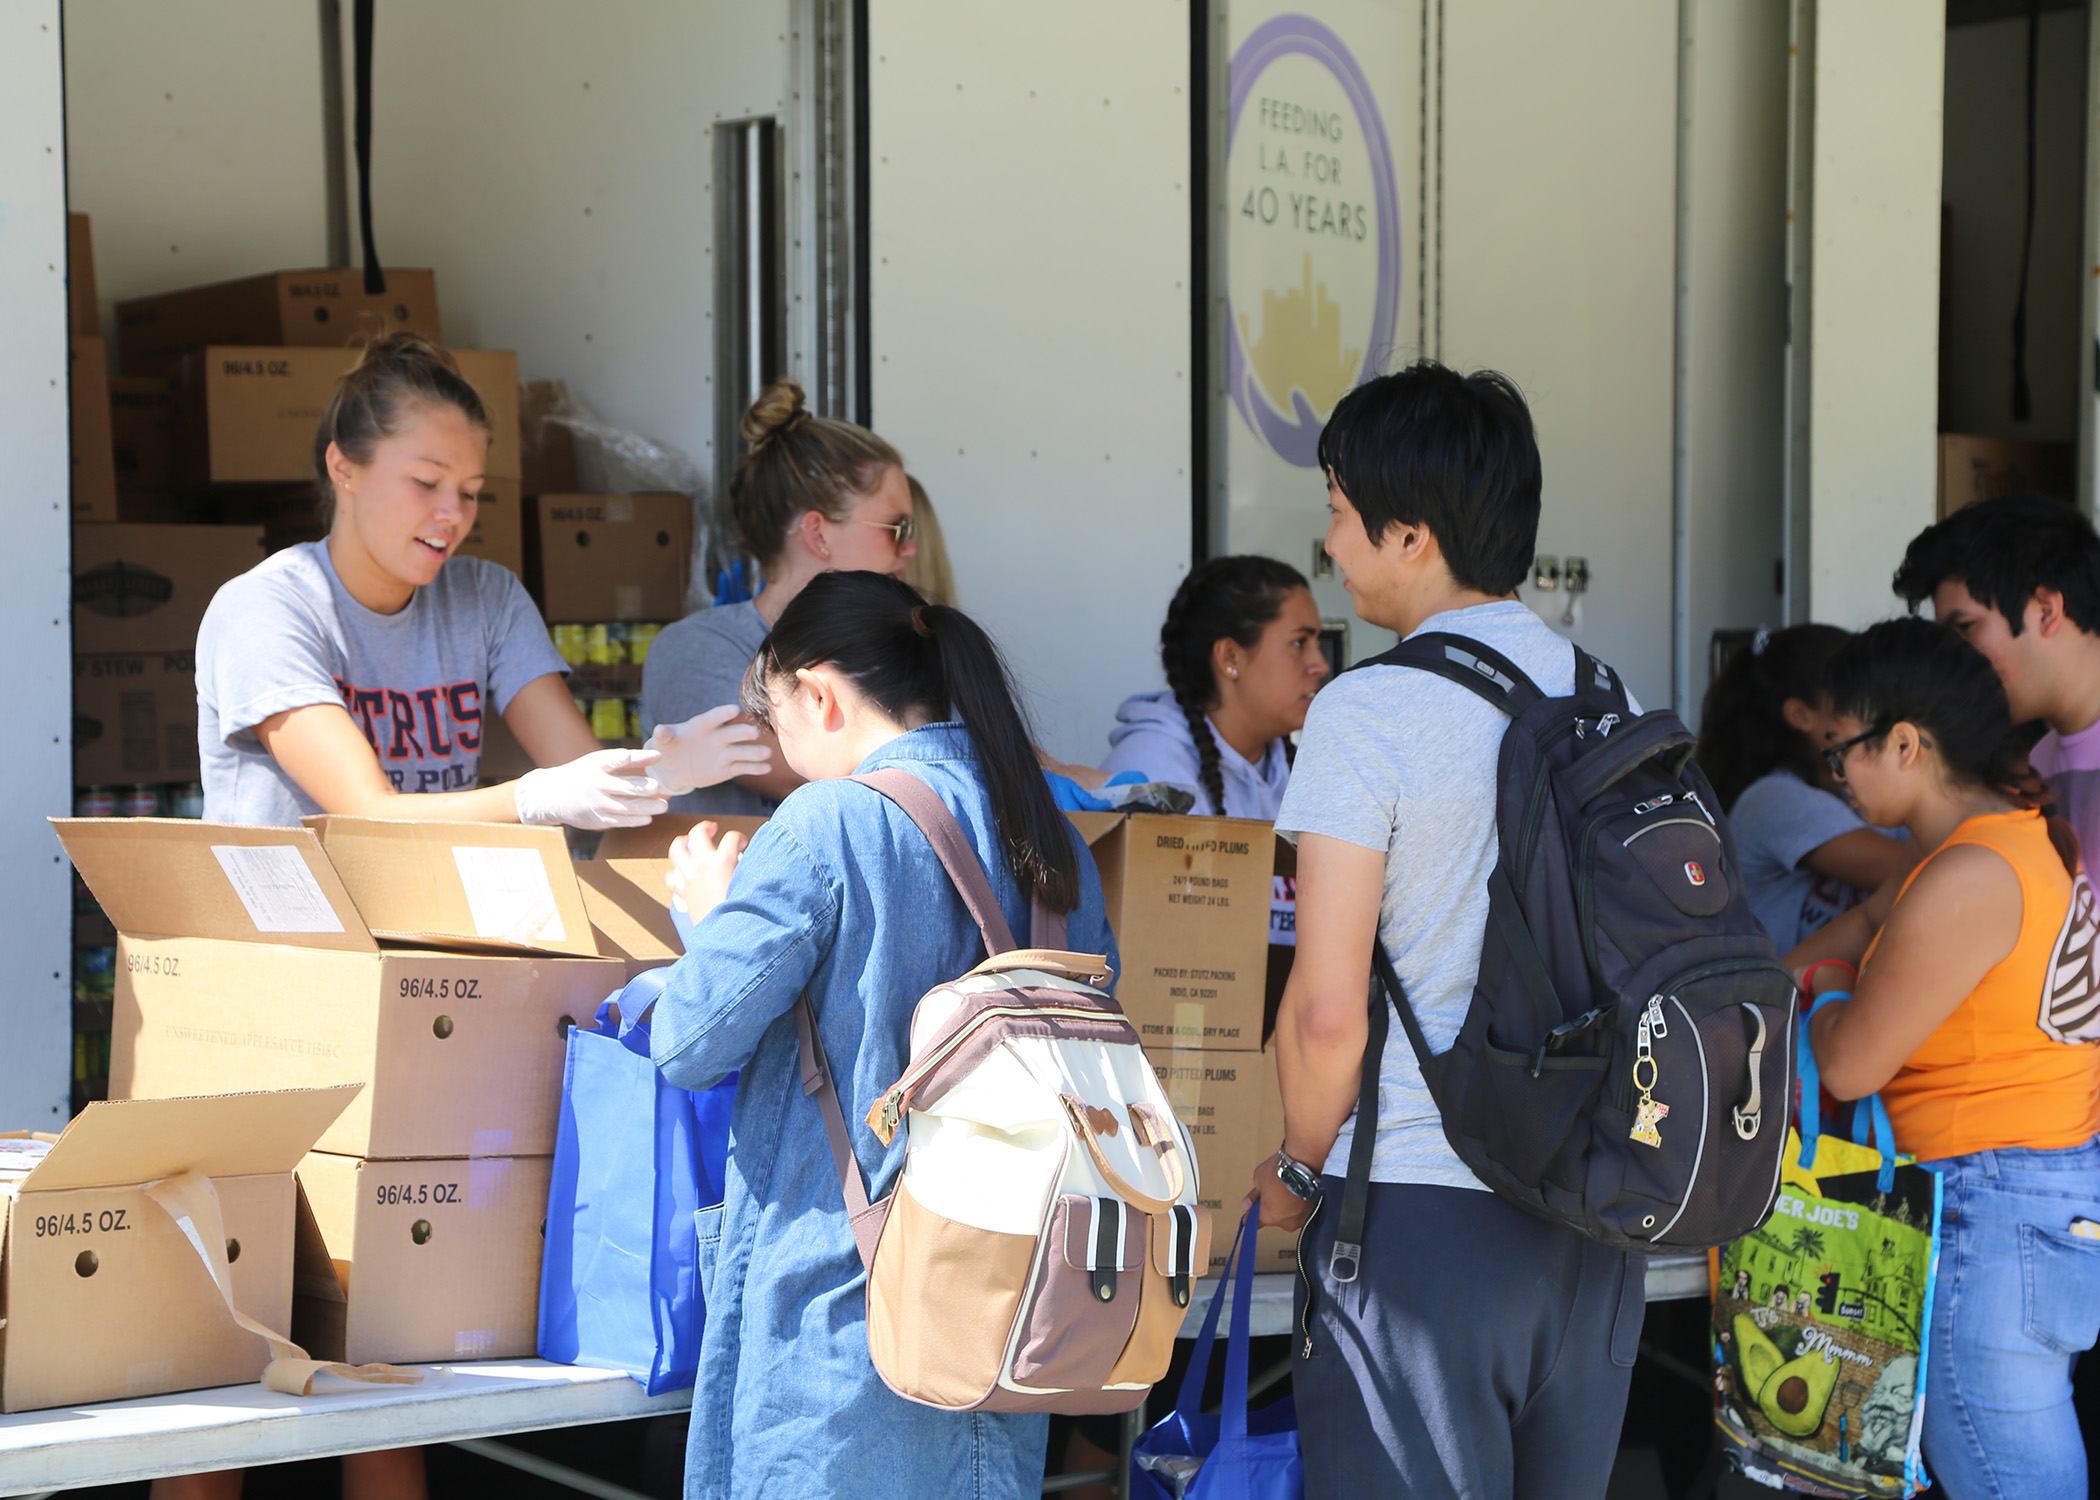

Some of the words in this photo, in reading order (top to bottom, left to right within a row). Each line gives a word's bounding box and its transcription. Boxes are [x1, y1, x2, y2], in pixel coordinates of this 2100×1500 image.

[1260, 97, 1343, 143] FEEDING
[1259, 142, 1296, 177] L.A.
[1303, 150, 1342, 186] FOR
[1241, 186, 1280, 227] 40
[1289, 190, 1368, 243] YEARS
[222, 360, 263, 376] 96/4.5
[267, 360, 292, 376] OZ.
[92, 659, 145, 677] STEW
[332, 675, 482, 761] TRUS
[1156, 834, 1185, 850] DRIED
[1219, 841, 1250, 856] PLUMS
[1172, 875, 1187, 886] 24/1
[1189, 876, 1211, 888] POUND
[1211, 877, 1229, 889] BAGS
[1168, 893, 1181, 904] NET
[1183, 894, 1206, 906] WEIGHT
[1207, 895, 1216, 906] 24
[1217, 896, 1231, 908] LBS.
[127, 953, 160, 974] 96/4.5
[163, 956, 182, 977] OZ.
[1153, 967, 1178, 979] PACKED
[1190, 969, 1210, 980] STUTZ
[1210, 970, 1236, 982] PACKING
[399, 977, 450, 999] 96/4.5
[454, 979, 482, 999] OZ.
[1190, 987, 1199, 998] CA
[164, 1024, 238, 1046] UNSWEETENED
[241, 1031, 305, 1054] APPLESAUCE
[1142, 1024, 1165, 1035] STORE
[1166, 1025, 1174, 1035] IN
[1203, 1027, 1218, 1038] DRY
[1219, 1028, 1240, 1038] PLACE
[1169, 1067, 1202, 1081] PITTED
[1204, 1068, 1237, 1082] PLUMS
[1197, 1105, 1215, 1117] BAGS
[1192, 1125, 1201, 1135] 24
[376, 1184, 428, 1205] 96/4.5
[433, 1183, 462, 1204] OZ.
[35, 1212, 93, 1238] 96/4.5
[98, 1209, 131, 1232] OZ.
[1805, 1204, 1860, 1231] JOE'S
